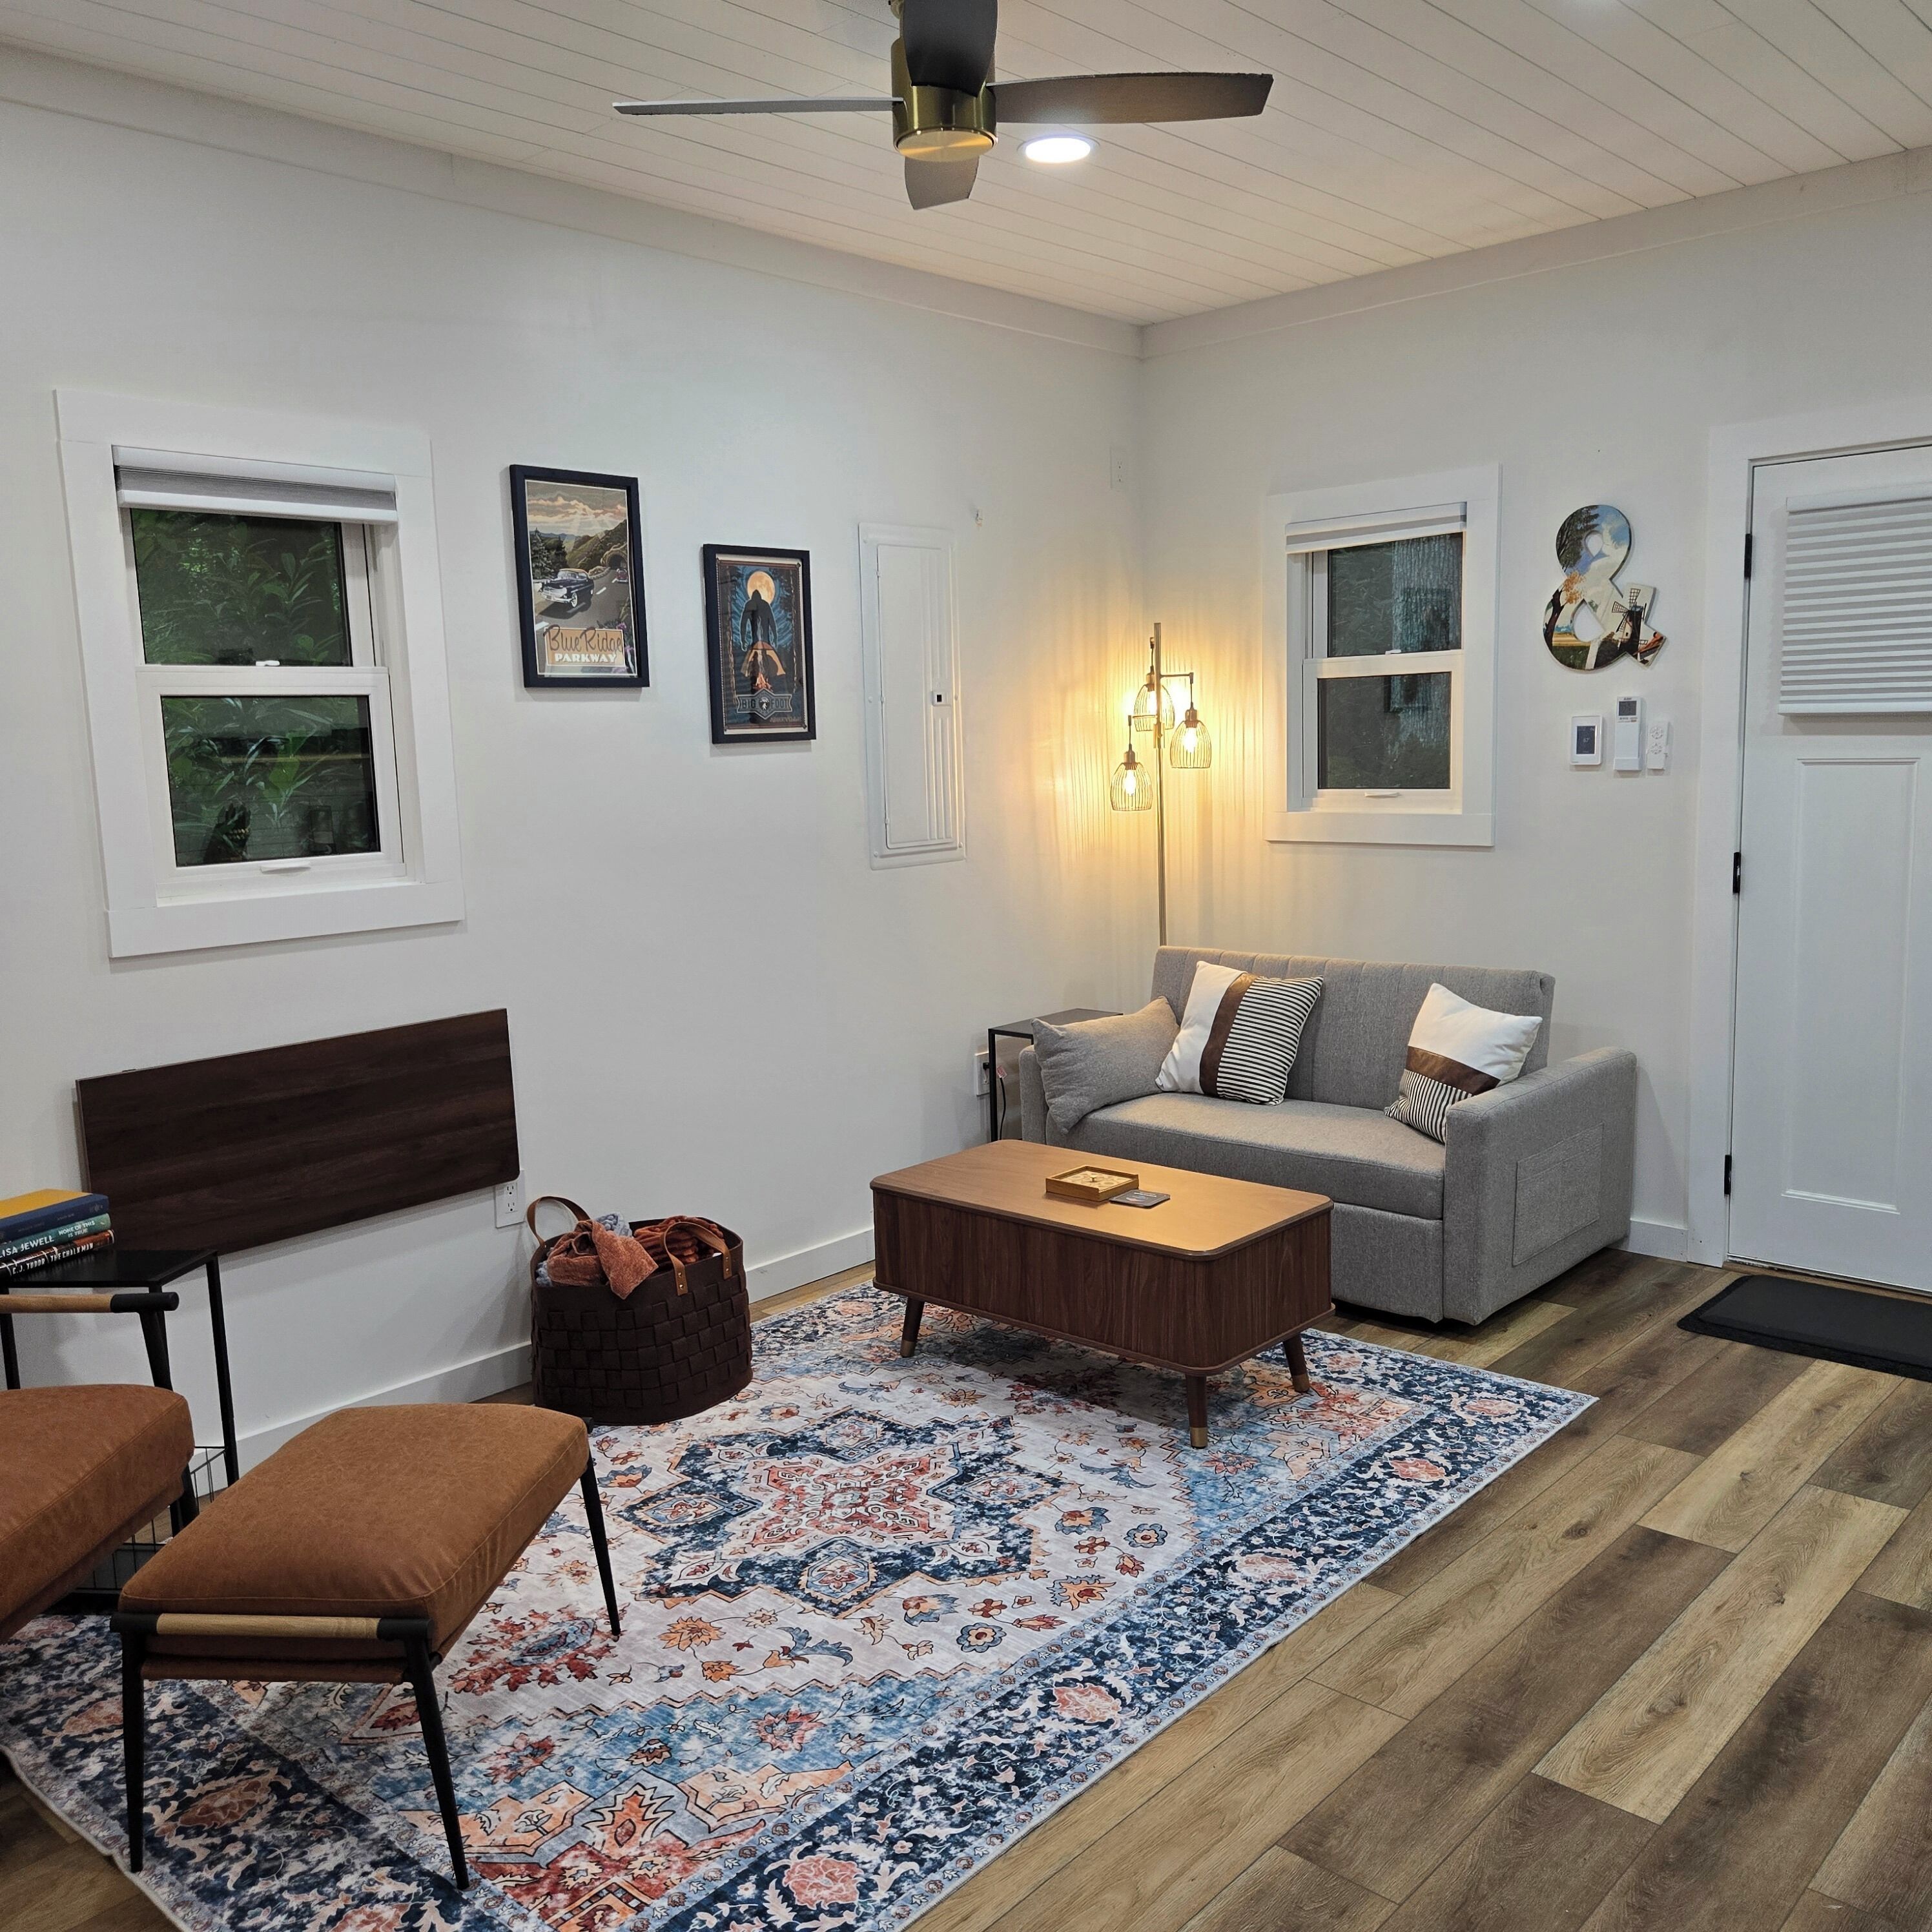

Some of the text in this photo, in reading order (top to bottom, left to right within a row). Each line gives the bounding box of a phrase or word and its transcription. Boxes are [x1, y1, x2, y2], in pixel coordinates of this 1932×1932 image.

[543, 624, 623, 653] Blue Ridge
[555, 653, 617, 663] PARKWAY
[741, 698, 788, 709] BIG FOOT
[58, 1226, 74, 1235] NONE
[21, 1235, 55, 1251] JEWELL
[50, 1253, 61, 1262] THE
[62, 1247, 81, 1259] CHALK
[26, 1258, 46, 1270] TUDOR
